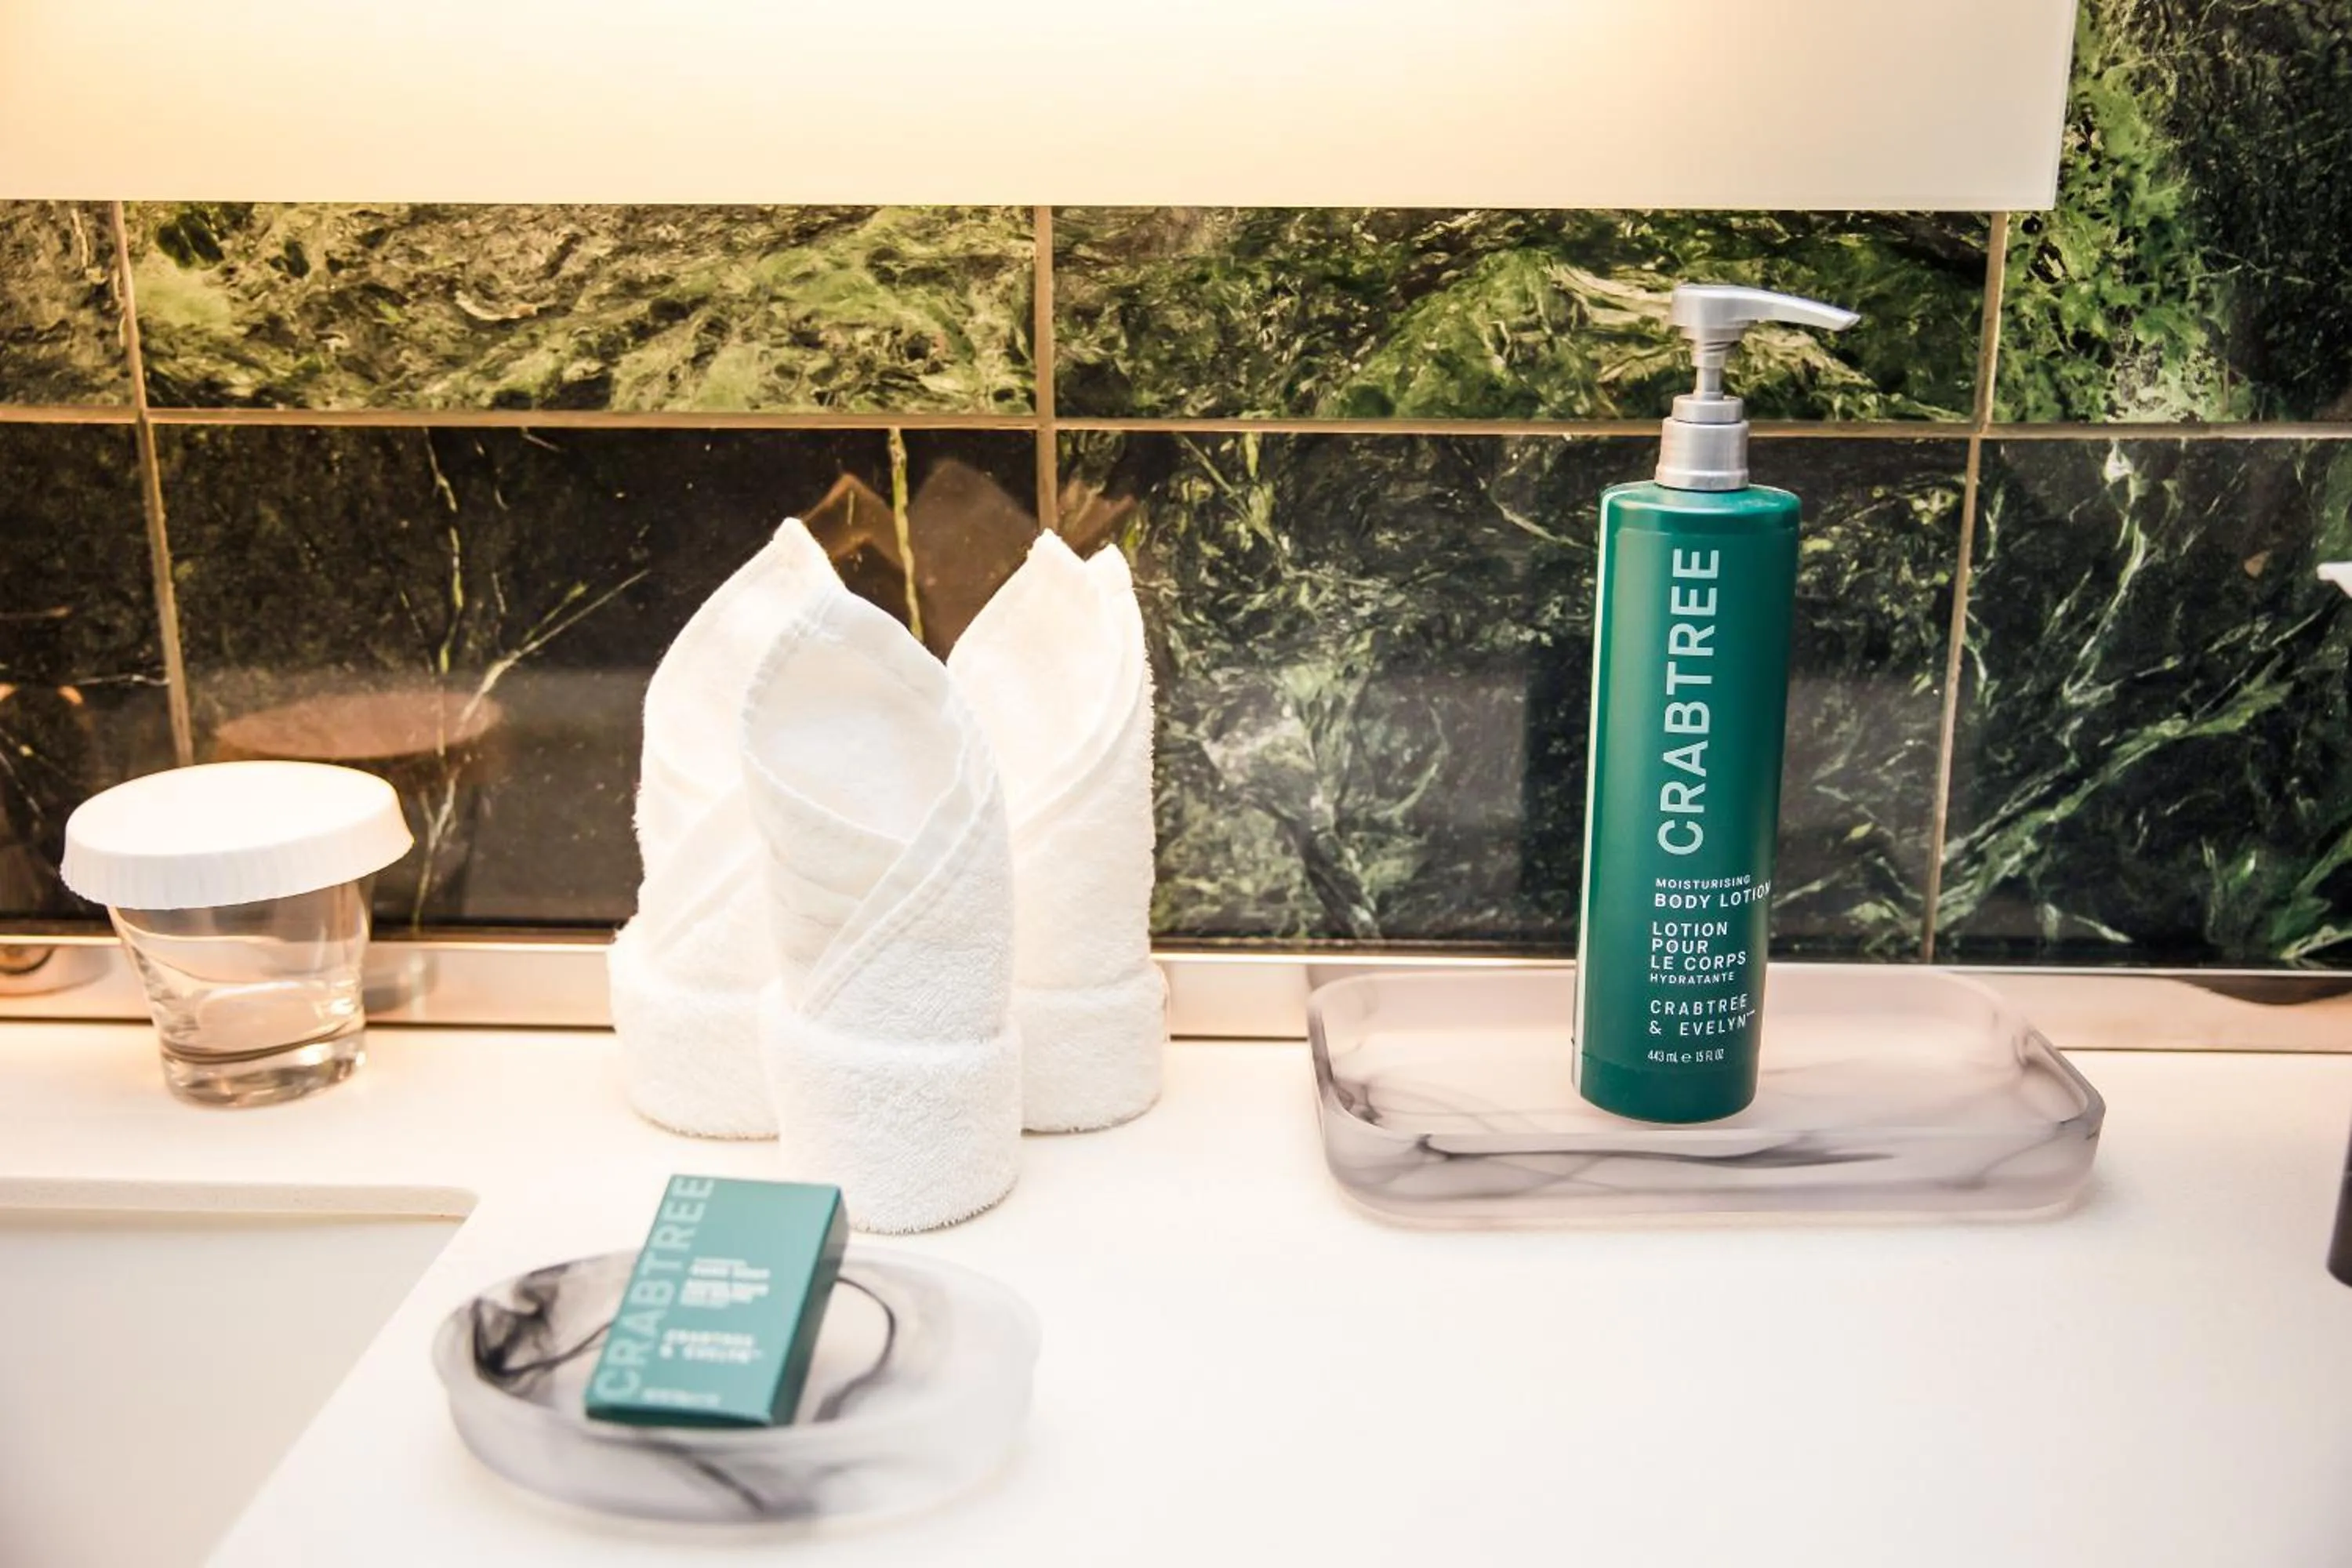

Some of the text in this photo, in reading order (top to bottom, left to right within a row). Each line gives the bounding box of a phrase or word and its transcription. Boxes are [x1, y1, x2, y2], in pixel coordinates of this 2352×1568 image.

[1657, 548, 1720, 855] CRABTREE
[1656, 874, 1751, 889] MOISTURISING
[1655, 879, 1771, 909] BODY LOTION
[1653, 921, 1728, 938] LOTION
[1652, 940, 1709, 954] POUR
[1650, 951, 1747, 971] LE CORPS
[1650, 971, 1735, 984] HYDRATANTE
[1650, 993, 1748, 1016] CRABTREE
[1649, 1020, 1662, 1036] &
[1647, 1050, 1664, 1062] 443
[593, 1176, 715, 1402] CRABTREE
